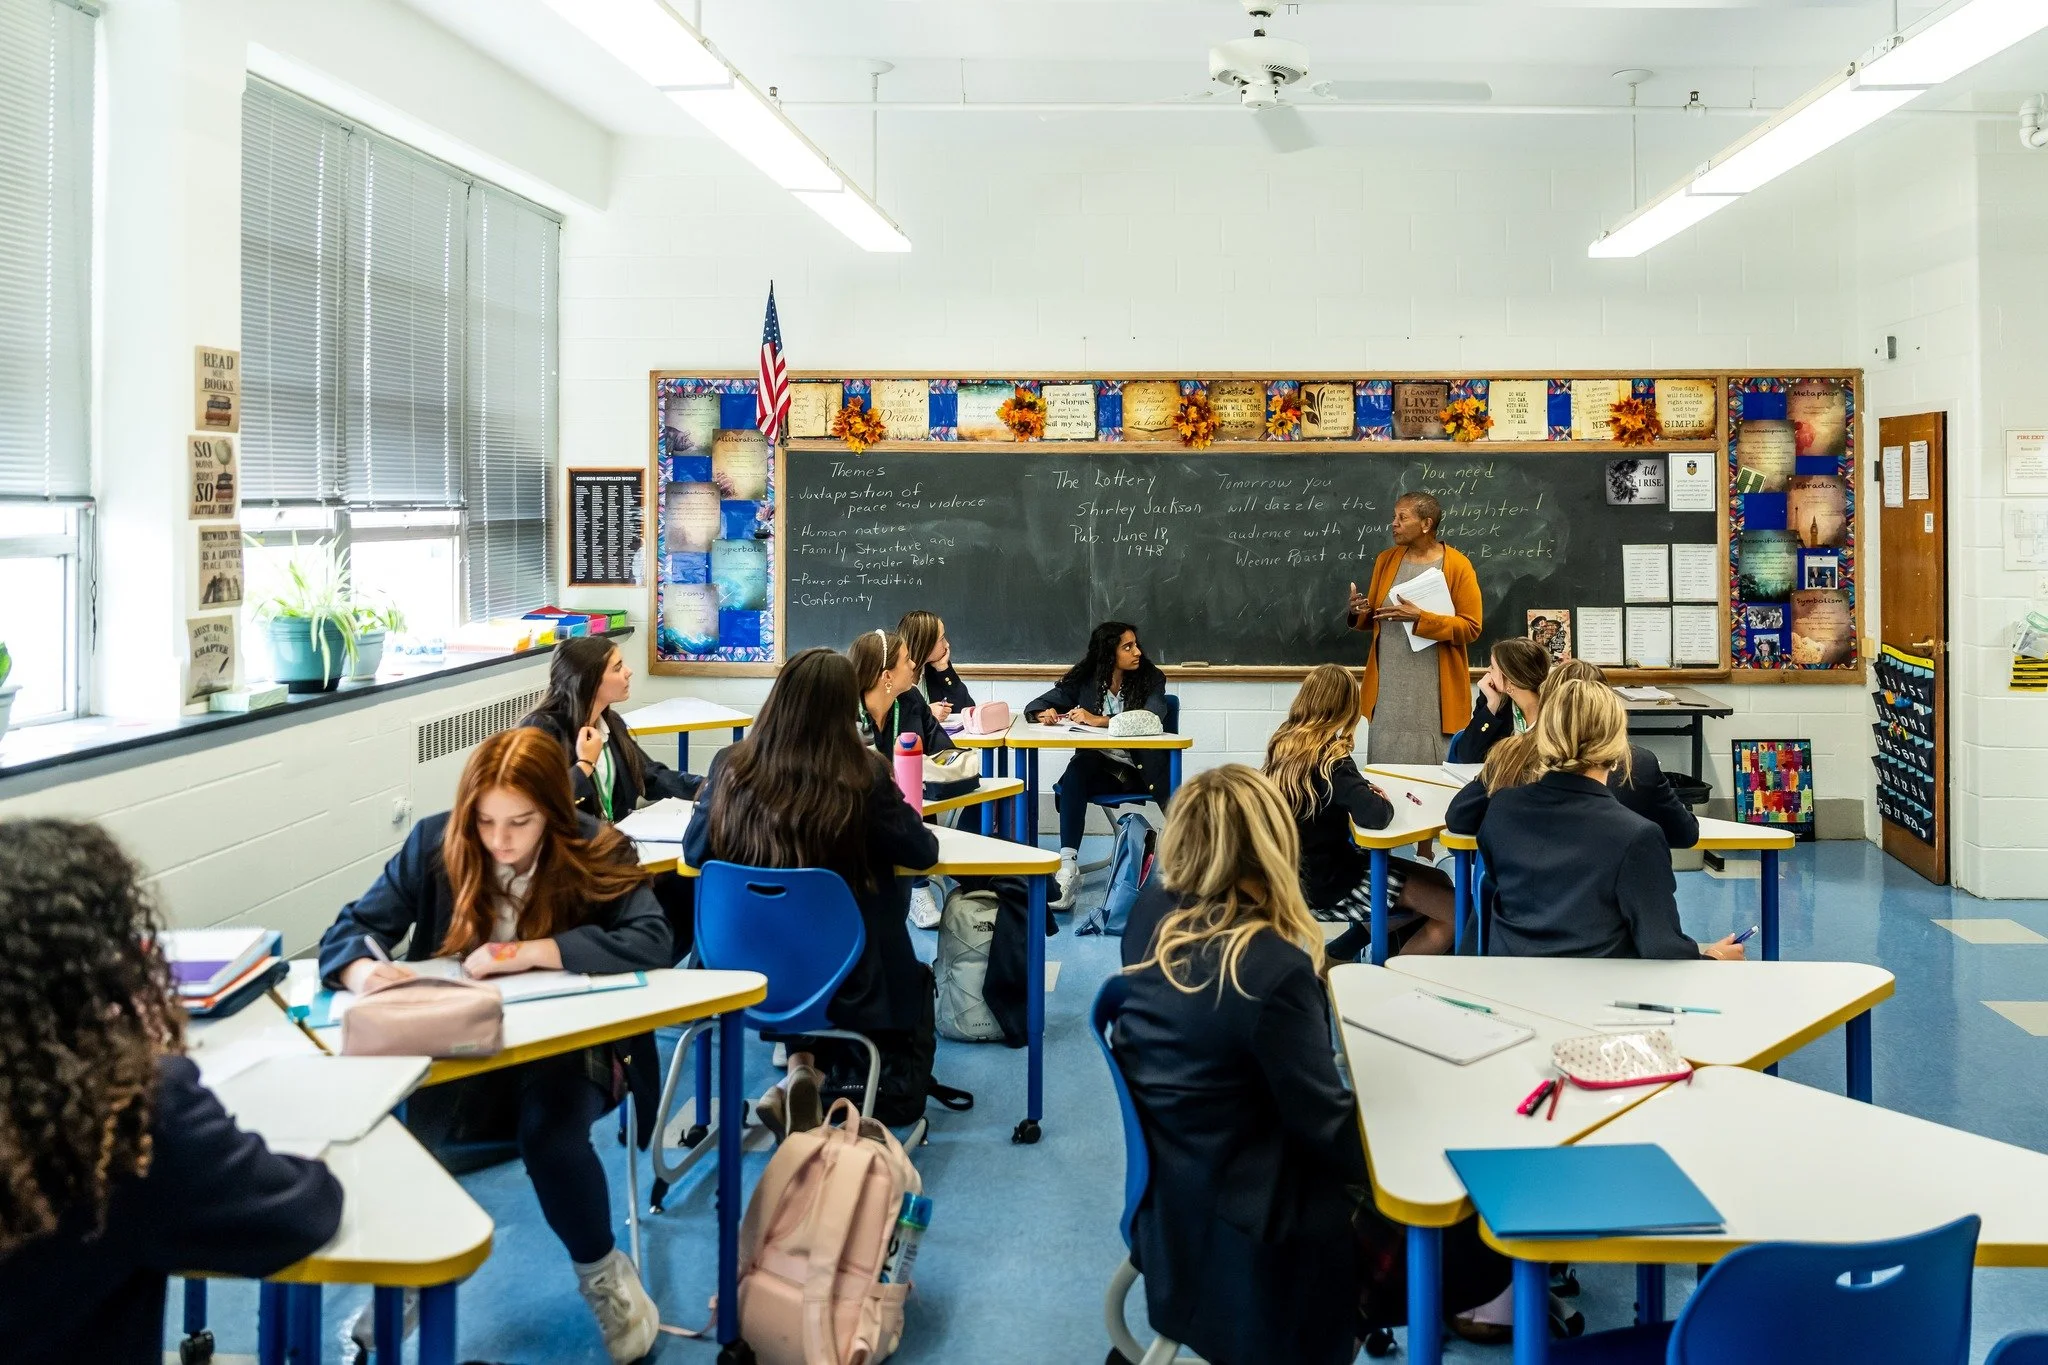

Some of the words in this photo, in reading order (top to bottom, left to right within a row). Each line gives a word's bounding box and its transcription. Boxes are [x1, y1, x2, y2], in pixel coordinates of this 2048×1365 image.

[204, 352, 234, 370] READ
[204, 378, 234, 391] BOOKS
[672, 392, 714, 402] Allegory
[1792, 390, 1840, 400] Metaphor
[1405, 398, 1439, 408] LIVE
[878, 408, 923, 422] Dreams
[1144, 414, 1171, 426] book
[1076, 420, 1092, 428] ship
[194, 441, 212, 458] SO
[830, 462, 886, 478] Themes
[1421, 462, 1446, 480] You
[1456, 462, 1494, 479] need
[1644, 465, 1658, 476] till
[1052, 470, 1080, 490] The
[1094, 468, 1156, 494] Lottery
[1218, 473, 1292, 490] Tomorrow
[1302, 477, 1332, 494] you
[1643, 478, 1664, 487] RISE.
[1796, 482, 1838, 490] Paradox
[196, 483, 214, 502] SO
[799, 483, 893, 504] Juxtaposition
[901, 482, 923, 498] of
[848, 504, 888, 518] peace
[896, 500, 920, 510] and
[929, 494, 986, 508] violence
[1076, 500, 1136, 524] Shirley
[1144, 496, 1202, 514] Jackson
[1228, 496, 1258, 513] will
[1264, 496, 1324, 510] dazzle
[1342, 496, 1376, 510] the
[202, 531, 228, 541] BETWEEN
[801, 524, 847, 538] Human
[855, 522, 906, 536] nature
[1070, 524, 1104, 544] Pub.
[1112, 524, 1148, 543] June
[1228, 524, 1292, 540] audience
[1304, 522, 1341, 538] with
[1357, 523, 1392, 542] your
[1436, 523, 1500, 538] otebook
[716, 546, 764, 556] Hyperbole
[801, 542, 846, 562] Family
[856, 542, 922, 555] Structure
[930, 537, 955, 547] and
[1128, 544, 1164, 556] 1948
[1338, 544, 1374, 560] act.
[1481, 544, 1493, 558] B
[854, 560, 903, 572] Gender
[910, 554, 946, 566] Roles
[801, 572, 832, 586] Power
[836, 575, 850, 586] of
[856, 572, 923, 586] Tradition
[677, 590, 706, 600] Irony
[800, 592, 873, 612] Conformity
[1796, 598, 1842, 606] Symbolism
[194, 624, 210, 638] JUST
[214, 624, 229, 634] ONE
[194, 644, 229, 658] CHAPTER
[1900, 682, 1906, 692] 4
[1908, 684, 1916, 696] 5
[1877, 704, 1882, 714] 7
